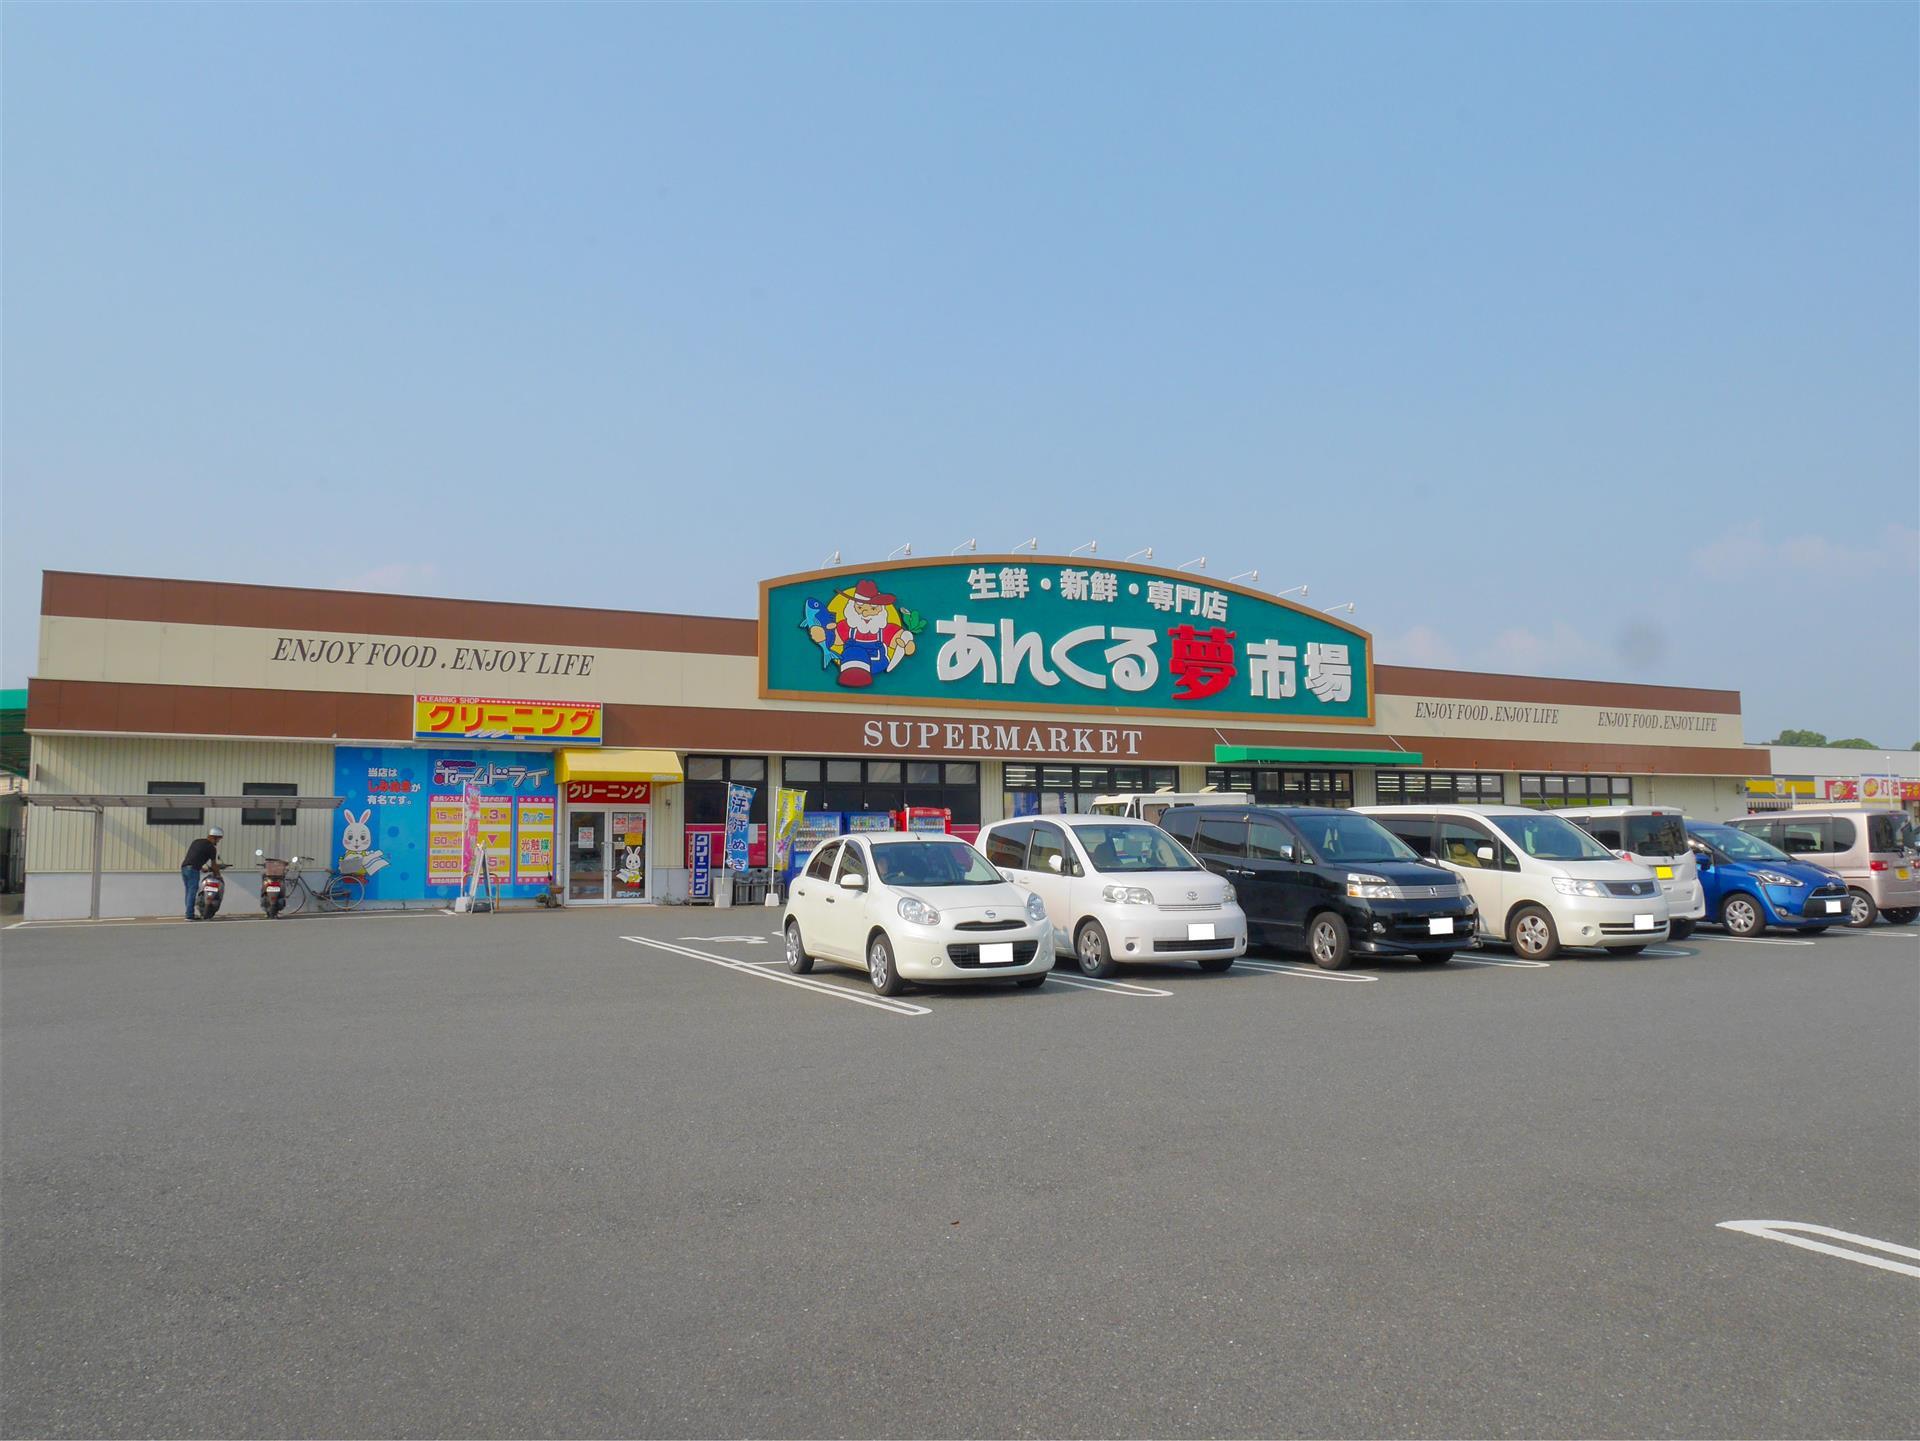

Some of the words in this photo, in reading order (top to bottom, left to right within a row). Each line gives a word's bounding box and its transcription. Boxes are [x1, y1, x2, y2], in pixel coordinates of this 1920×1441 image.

[271, 637, 363, 665] ENJOY
[450, 647, 534, 674] ENJOY
[535, 653, 595, 677] LIFE
[419, 696, 457, 704] CLEANING
[429, 705, 595, 736] クリーニング
[1415, 702, 1456, 720] ENJOY
[1494, 706, 1532, 723] ENJOY
[1533, 708, 1559, 725] LIFE
[1598, 711, 1632, 728] ENJOY
[1663, 715, 1696, 731] ENJOY
[1695, 717, 1718, 732] LIFE
[863, 720, 1142, 754] SUPERMARKET
[368, 767, 398, 777] 当店は
[568, 783, 648, 799] クリーニング
